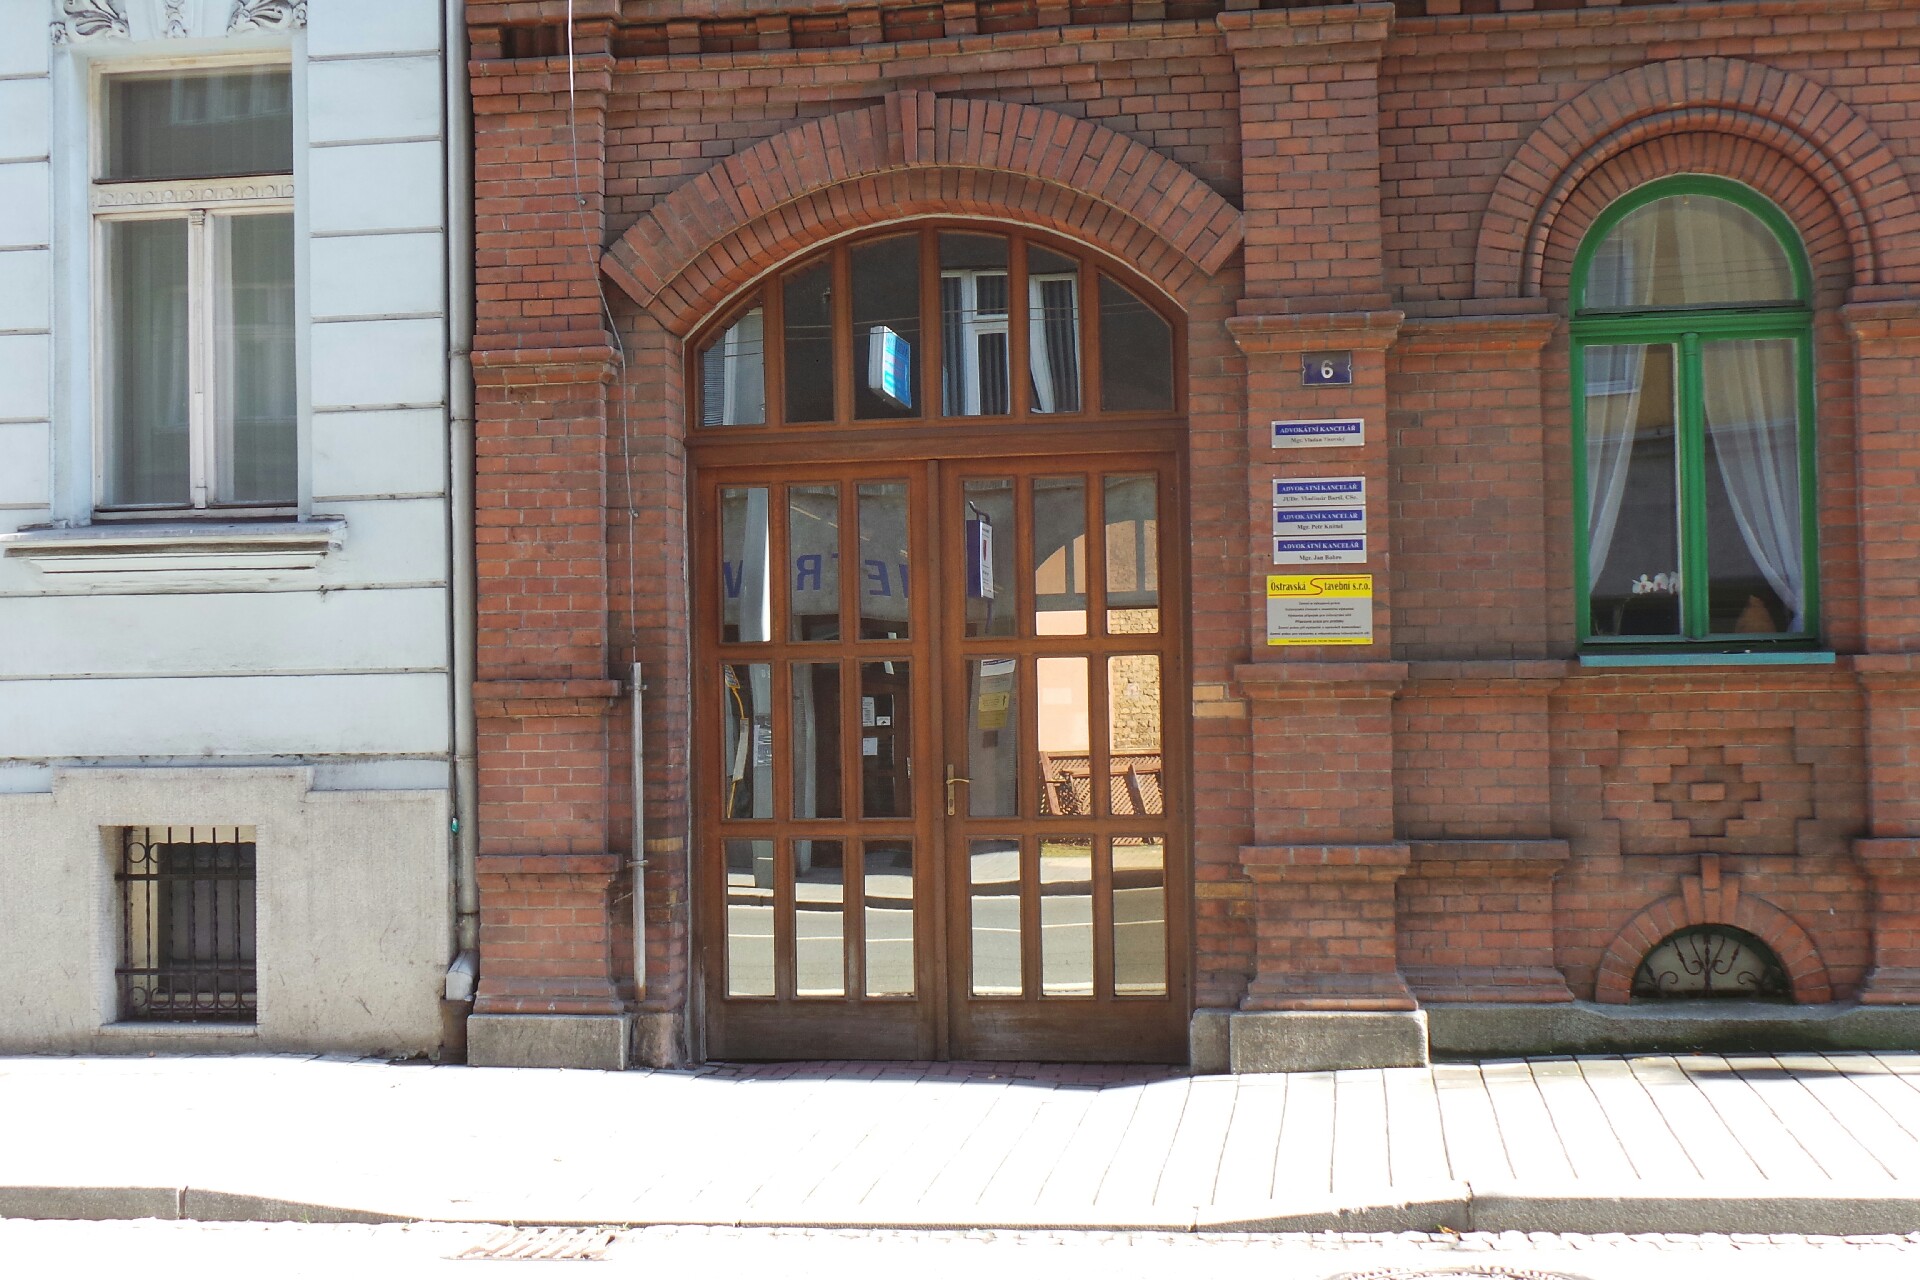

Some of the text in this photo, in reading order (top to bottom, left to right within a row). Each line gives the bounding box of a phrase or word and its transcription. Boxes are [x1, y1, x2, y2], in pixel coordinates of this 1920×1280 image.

[1320, 360, 1334, 379] 6
[1280, 425, 1356, 434] ADVOKÁTNÍ KANCELÁŘ
[1282, 483, 1358, 492] ADVOKÁTNÍ KANCELÁŘ
[1322, 541, 1359, 549] KANCELÁŘ
[1270, 582, 1306, 591] Ostravská
[1352, 583, 1371, 591] s.r.o.
